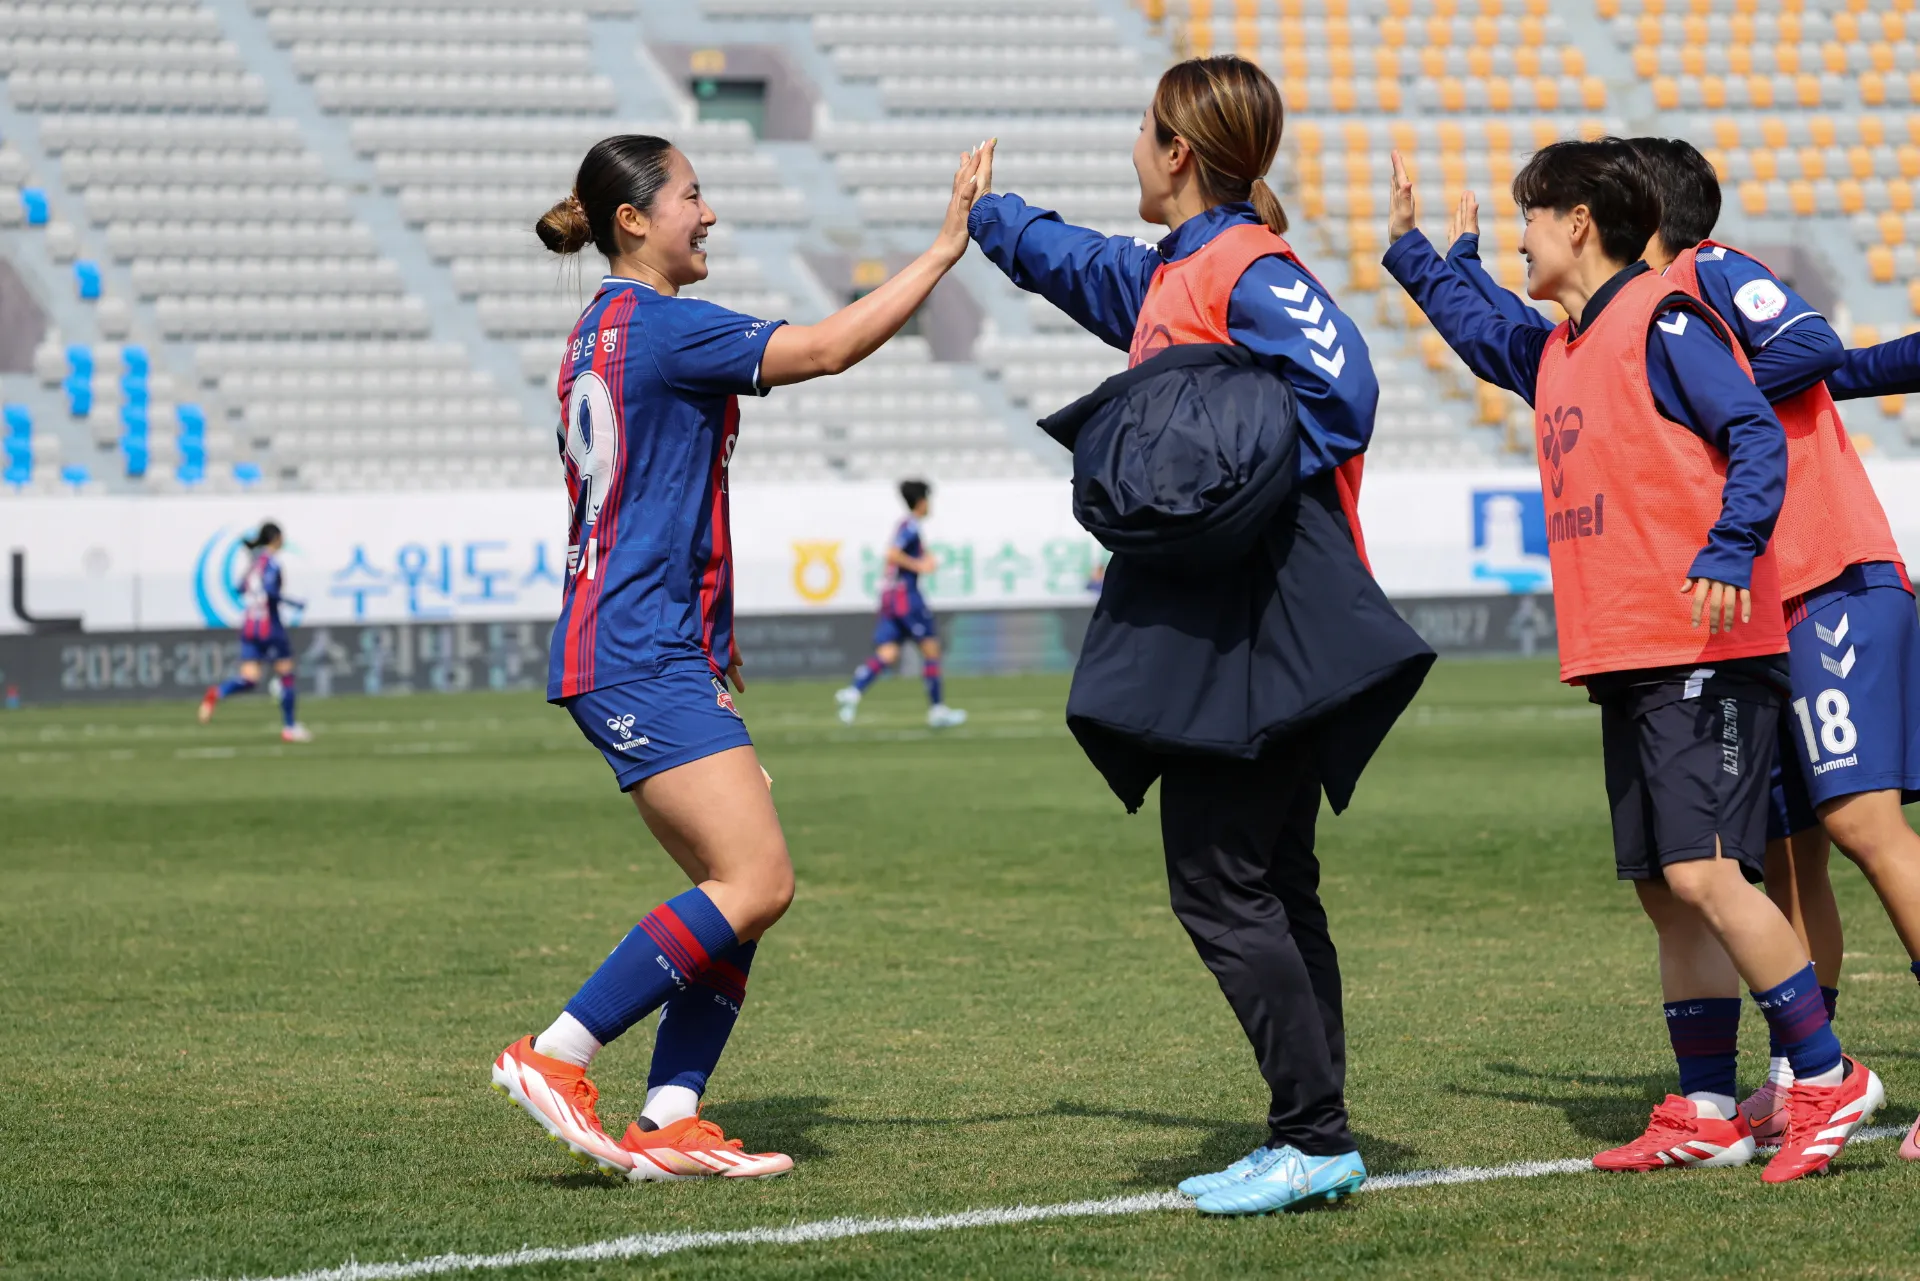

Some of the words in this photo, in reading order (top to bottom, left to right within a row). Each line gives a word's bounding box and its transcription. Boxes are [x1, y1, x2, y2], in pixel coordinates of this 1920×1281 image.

[563, 328, 618, 364] 업은행
[1793, 688, 1858, 763] 18
[612, 735, 650, 752] hummel
[1813, 753, 1858, 777] hummel
